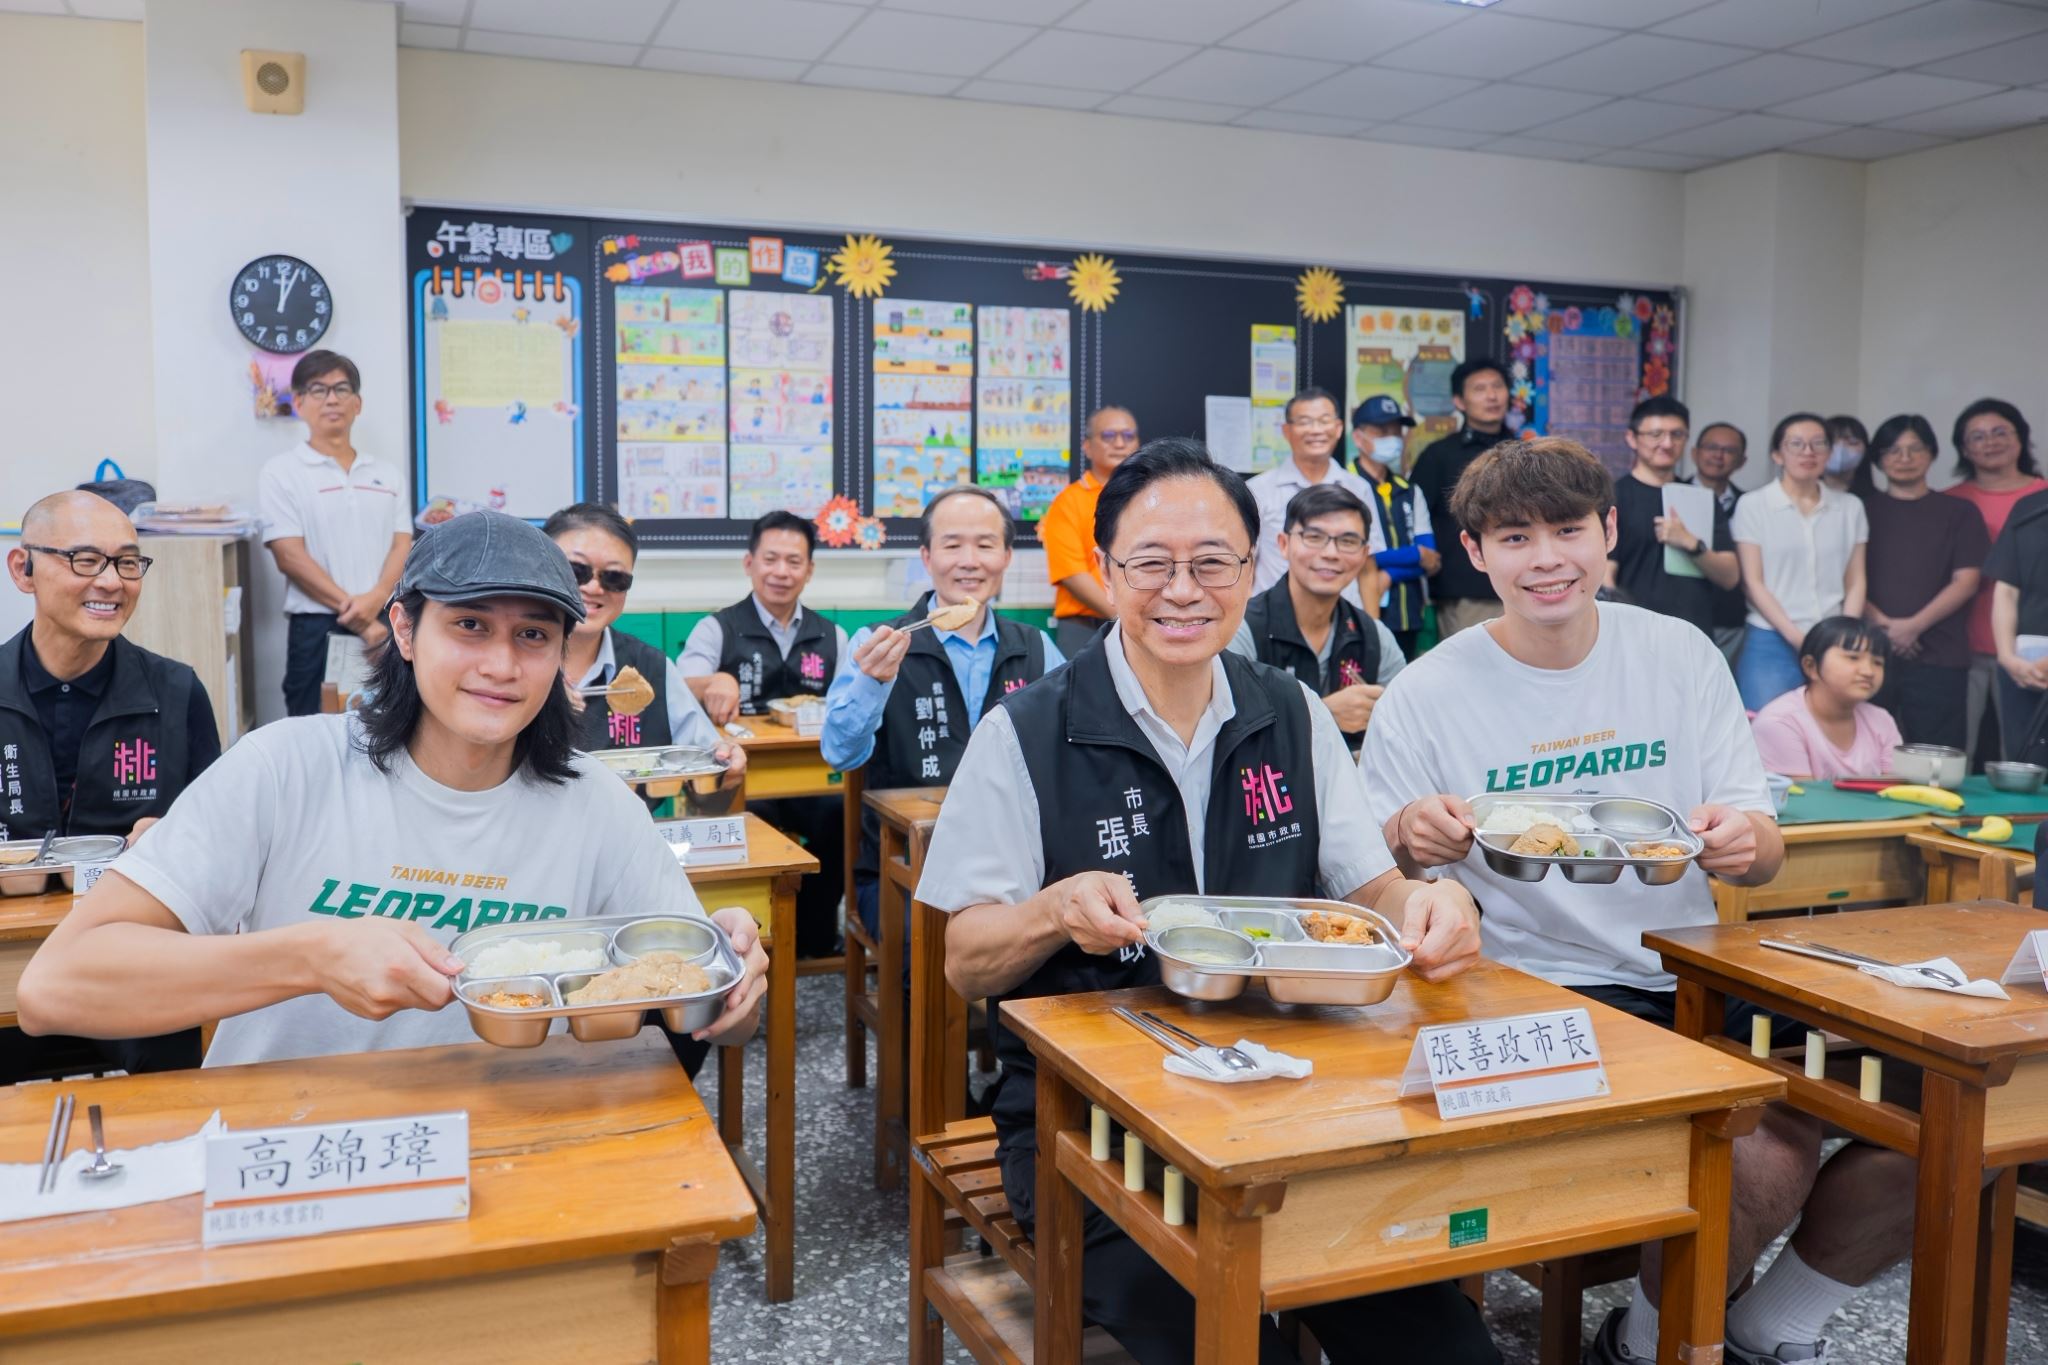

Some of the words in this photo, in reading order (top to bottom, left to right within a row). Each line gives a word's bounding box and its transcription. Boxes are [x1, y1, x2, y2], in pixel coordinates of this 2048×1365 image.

[437, 220, 555, 260] 午餐專區
[258, 265, 270, 279] 11
[276, 262, 291, 275] 12
[301, 267, 307, 282] 1
[245, 279, 259, 293] 10
[310, 284, 321, 297] 2
[237, 294, 249, 308] 9
[315, 301, 326, 314] 3
[243, 312, 255, 326] 8
[309, 318, 320, 330] 4
[257, 326, 268, 343] 7
[276, 333, 288, 347] 6
[296, 329, 307, 343] 5
[915, 697, 940, 778] 劉仲成
[1531, 737, 1580, 755] TAIWAN
[1584, 729, 1616, 745] BEER
[1486, 740, 1666, 793] LEOPARDS
[4, 744, 24, 815] 衛生局長
[1123, 787, 1150, 837] 市長
[1247, 822, 1301, 844] 桃園市政府
[391, 864, 458, 886] TAIWAN
[461, 874, 508, 890] BEER
[1430, 1016, 1592, 1076] 張善政市長
[1442, 1086, 1512, 1111] 桃園市政府
[238, 1122, 441, 1189] 高錦瑋
